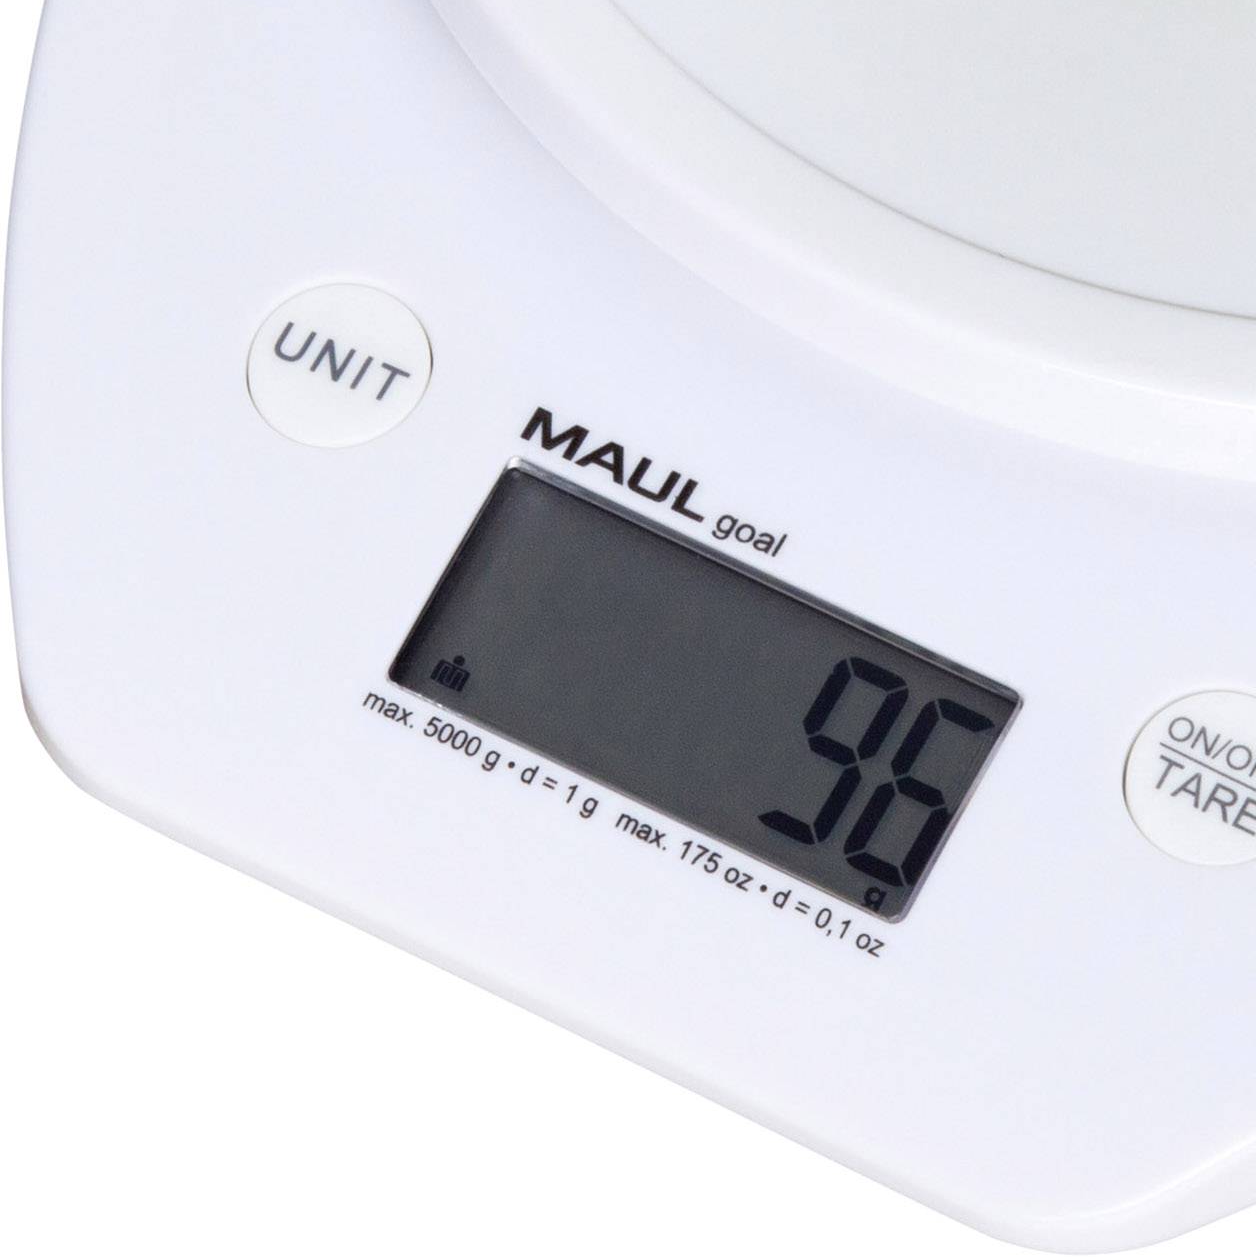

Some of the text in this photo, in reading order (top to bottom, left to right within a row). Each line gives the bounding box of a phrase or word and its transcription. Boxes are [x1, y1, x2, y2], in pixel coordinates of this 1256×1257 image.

[273, 321, 411, 401] UNIT
[519, 406, 789, 559] MAUL goal
[362, 691, 414, 729] max.
[422, 715, 483, 758] 5000
[480, 749, 502, 773] g
[519, 765, 540, 786] d
[565, 784, 579, 805] 1
[578, 796, 600, 820] g
[614, 812, 667, 851] max.
[680, 840, 724, 874] 175
[723, 866, 755, 893] oz
[772, 889, 793, 910] d
[814, 907, 853, 940] 0,1
[855, 932, 886, 958] oz
[757, 656, 996, 888] 96
